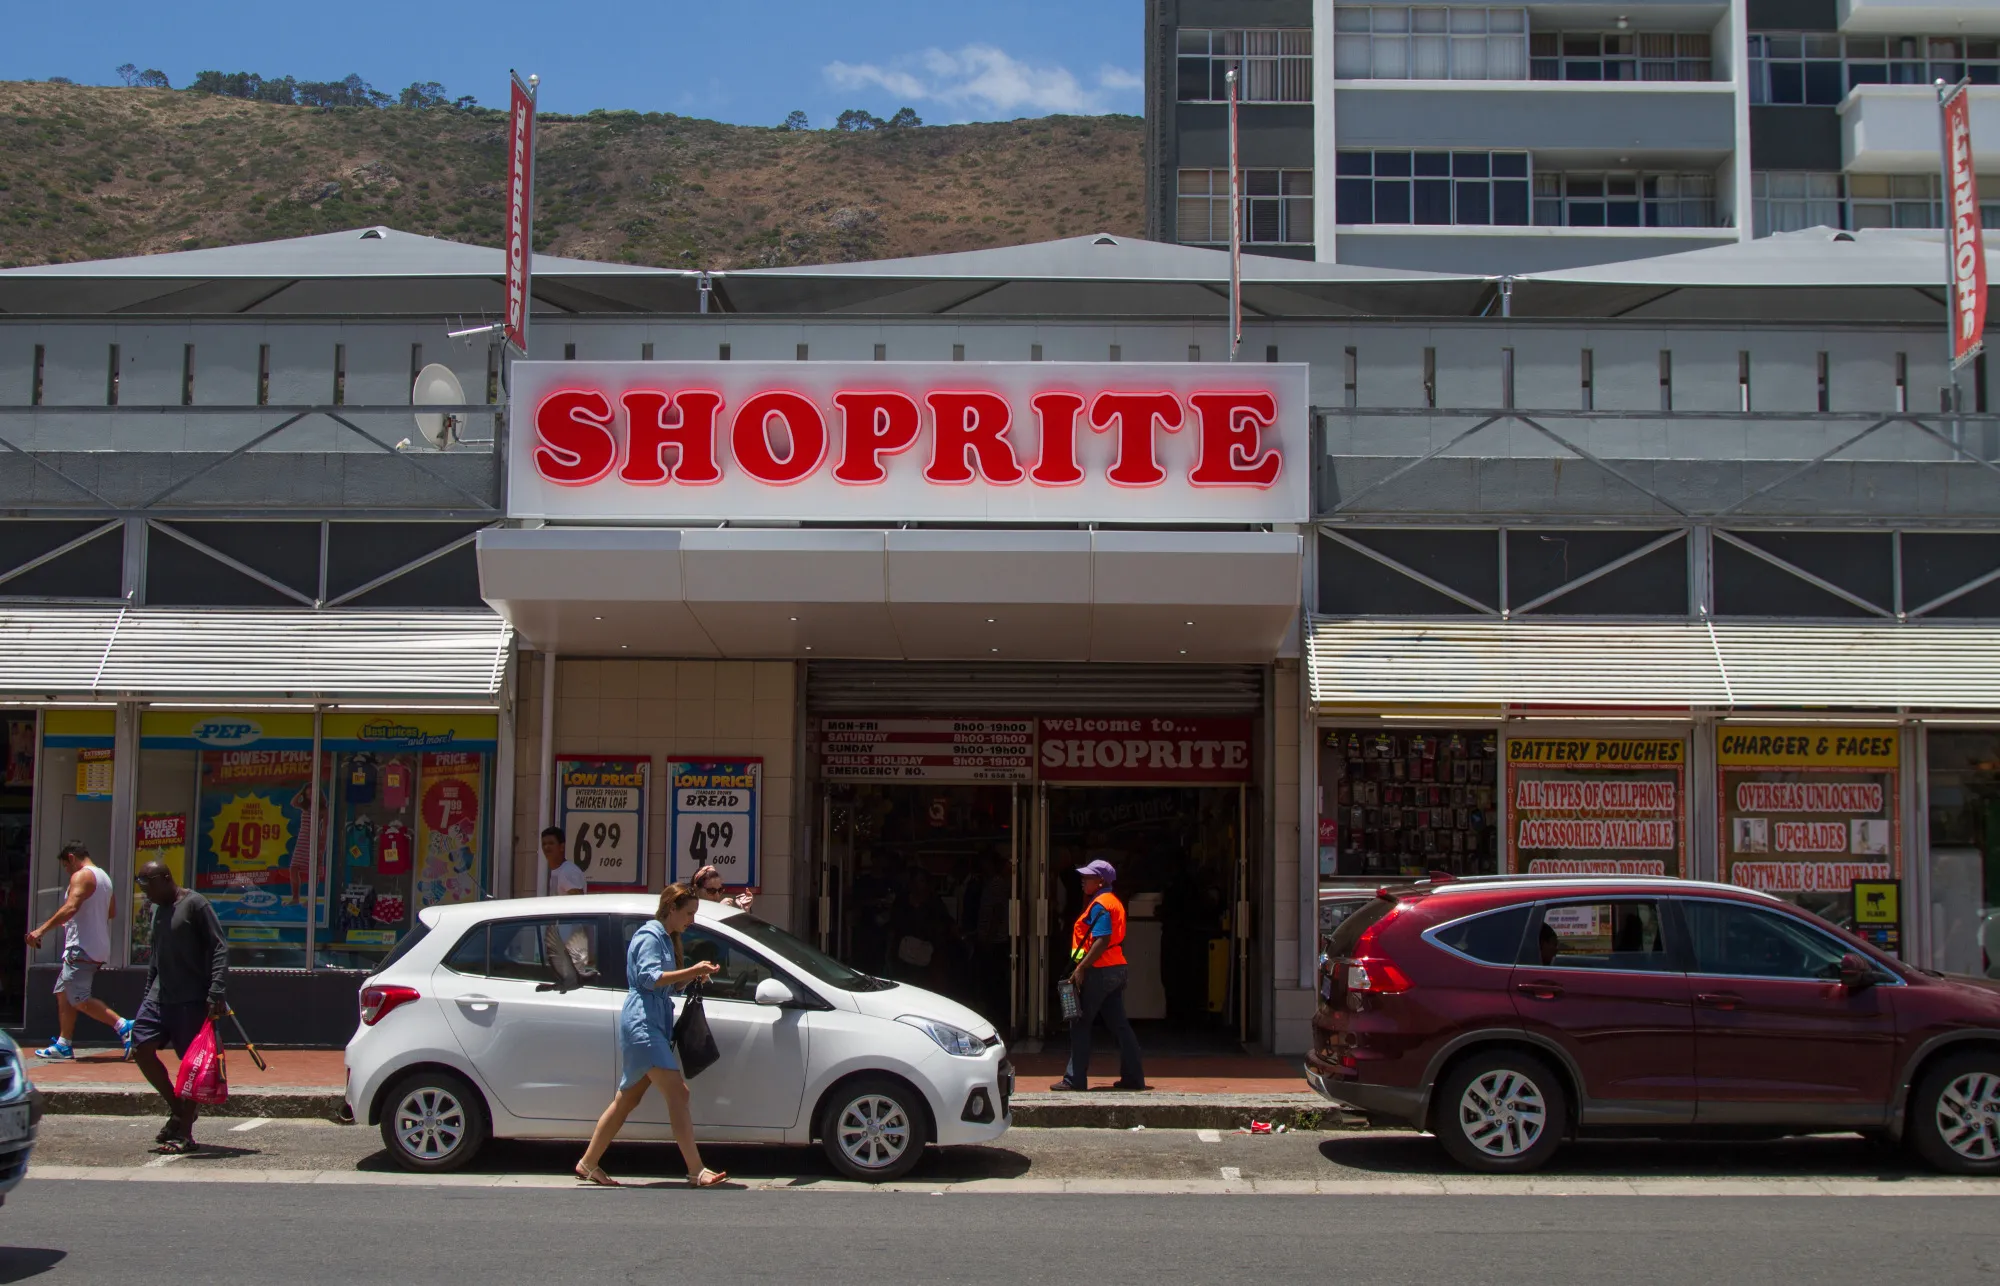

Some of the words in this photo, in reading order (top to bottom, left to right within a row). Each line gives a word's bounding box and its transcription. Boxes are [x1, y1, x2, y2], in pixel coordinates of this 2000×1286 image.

[509, 101, 527, 332] SHOPRITE
[1951, 107, 1977, 341] SHOPRITE
[534, 388, 1282, 487] SHOPRITE
[199, 724, 252, 738] PEP
[828, 721, 878, 731] MON-FRI
[953, 722, 1027, 732] 8h00-19h00
[1042, 718, 1141, 733] welcome
[1150, 717, 1198, 733] to...
[827, 733, 889, 742] SATURDAY
[953, 734, 1027, 743] 8h00-19h00
[828, 744, 874, 753] SUNDAY
[953, 745, 1026, 755] 9h00-19h00
[1510, 741, 1591, 761] BATTERY
[1596, 742, 1680, 761] POUCHES
[1722, 736, 1810, 756] CHARGER
[1816, 737, 1829, 756] &
[1836, 737, 1893, 756] FACES
[222, 750, 279, 766] LOWEST
[435, 752, 468, 766] PRICE
[1041, 739, 1249, 769] SHOPRITE
[827, 756, 870, 765] PUBLIC
[873, 756, 924, 766] HOLIDAY
[952, 757, 1026, 766] 9h00-19h00
[233, 764, 272, 777] SOUTH
[827, 766, 900, 776] EMERGENCY
[905, 767, 925, 776] NO.
[563, 773, 599, 786] LOW
[601, 773, 644, 786] PRICE
[674, 775, 708, 787] LOW
[712, 775, 754, 787] PRICE
[685, 795, 739, 807] BREAD
[1518, 782, 1542, 808] ALL
[1543, 782, 1582, 808] TYPES
[1584, 783, 1600, 808] OF
[1602, 783, 1673, 809] CELLPHONE
[1738, 784, 1803, 809] OVERSEAS
[1806, 784, 1880, 810] UNLOCKING
[575, 796, 607, 809] CHICKEN
[609, 796, 628, 809] LOAF
[143, 818, 180, 831] LOWEST
[144, 828, 178, 840] PRICES
[1520, 822, 1602, 847] ACCESSORIES
[1604, 822, 1672, 848] AVAILABLE
[1776, 825, 1844, 850] UPGRADES
[599, 857, 623, 867] 100G
[712, 855, 737, 865] 600G
[1733, 864, 1802, 889] SOFTWARE
[1803, 864, 1813, 890] &
